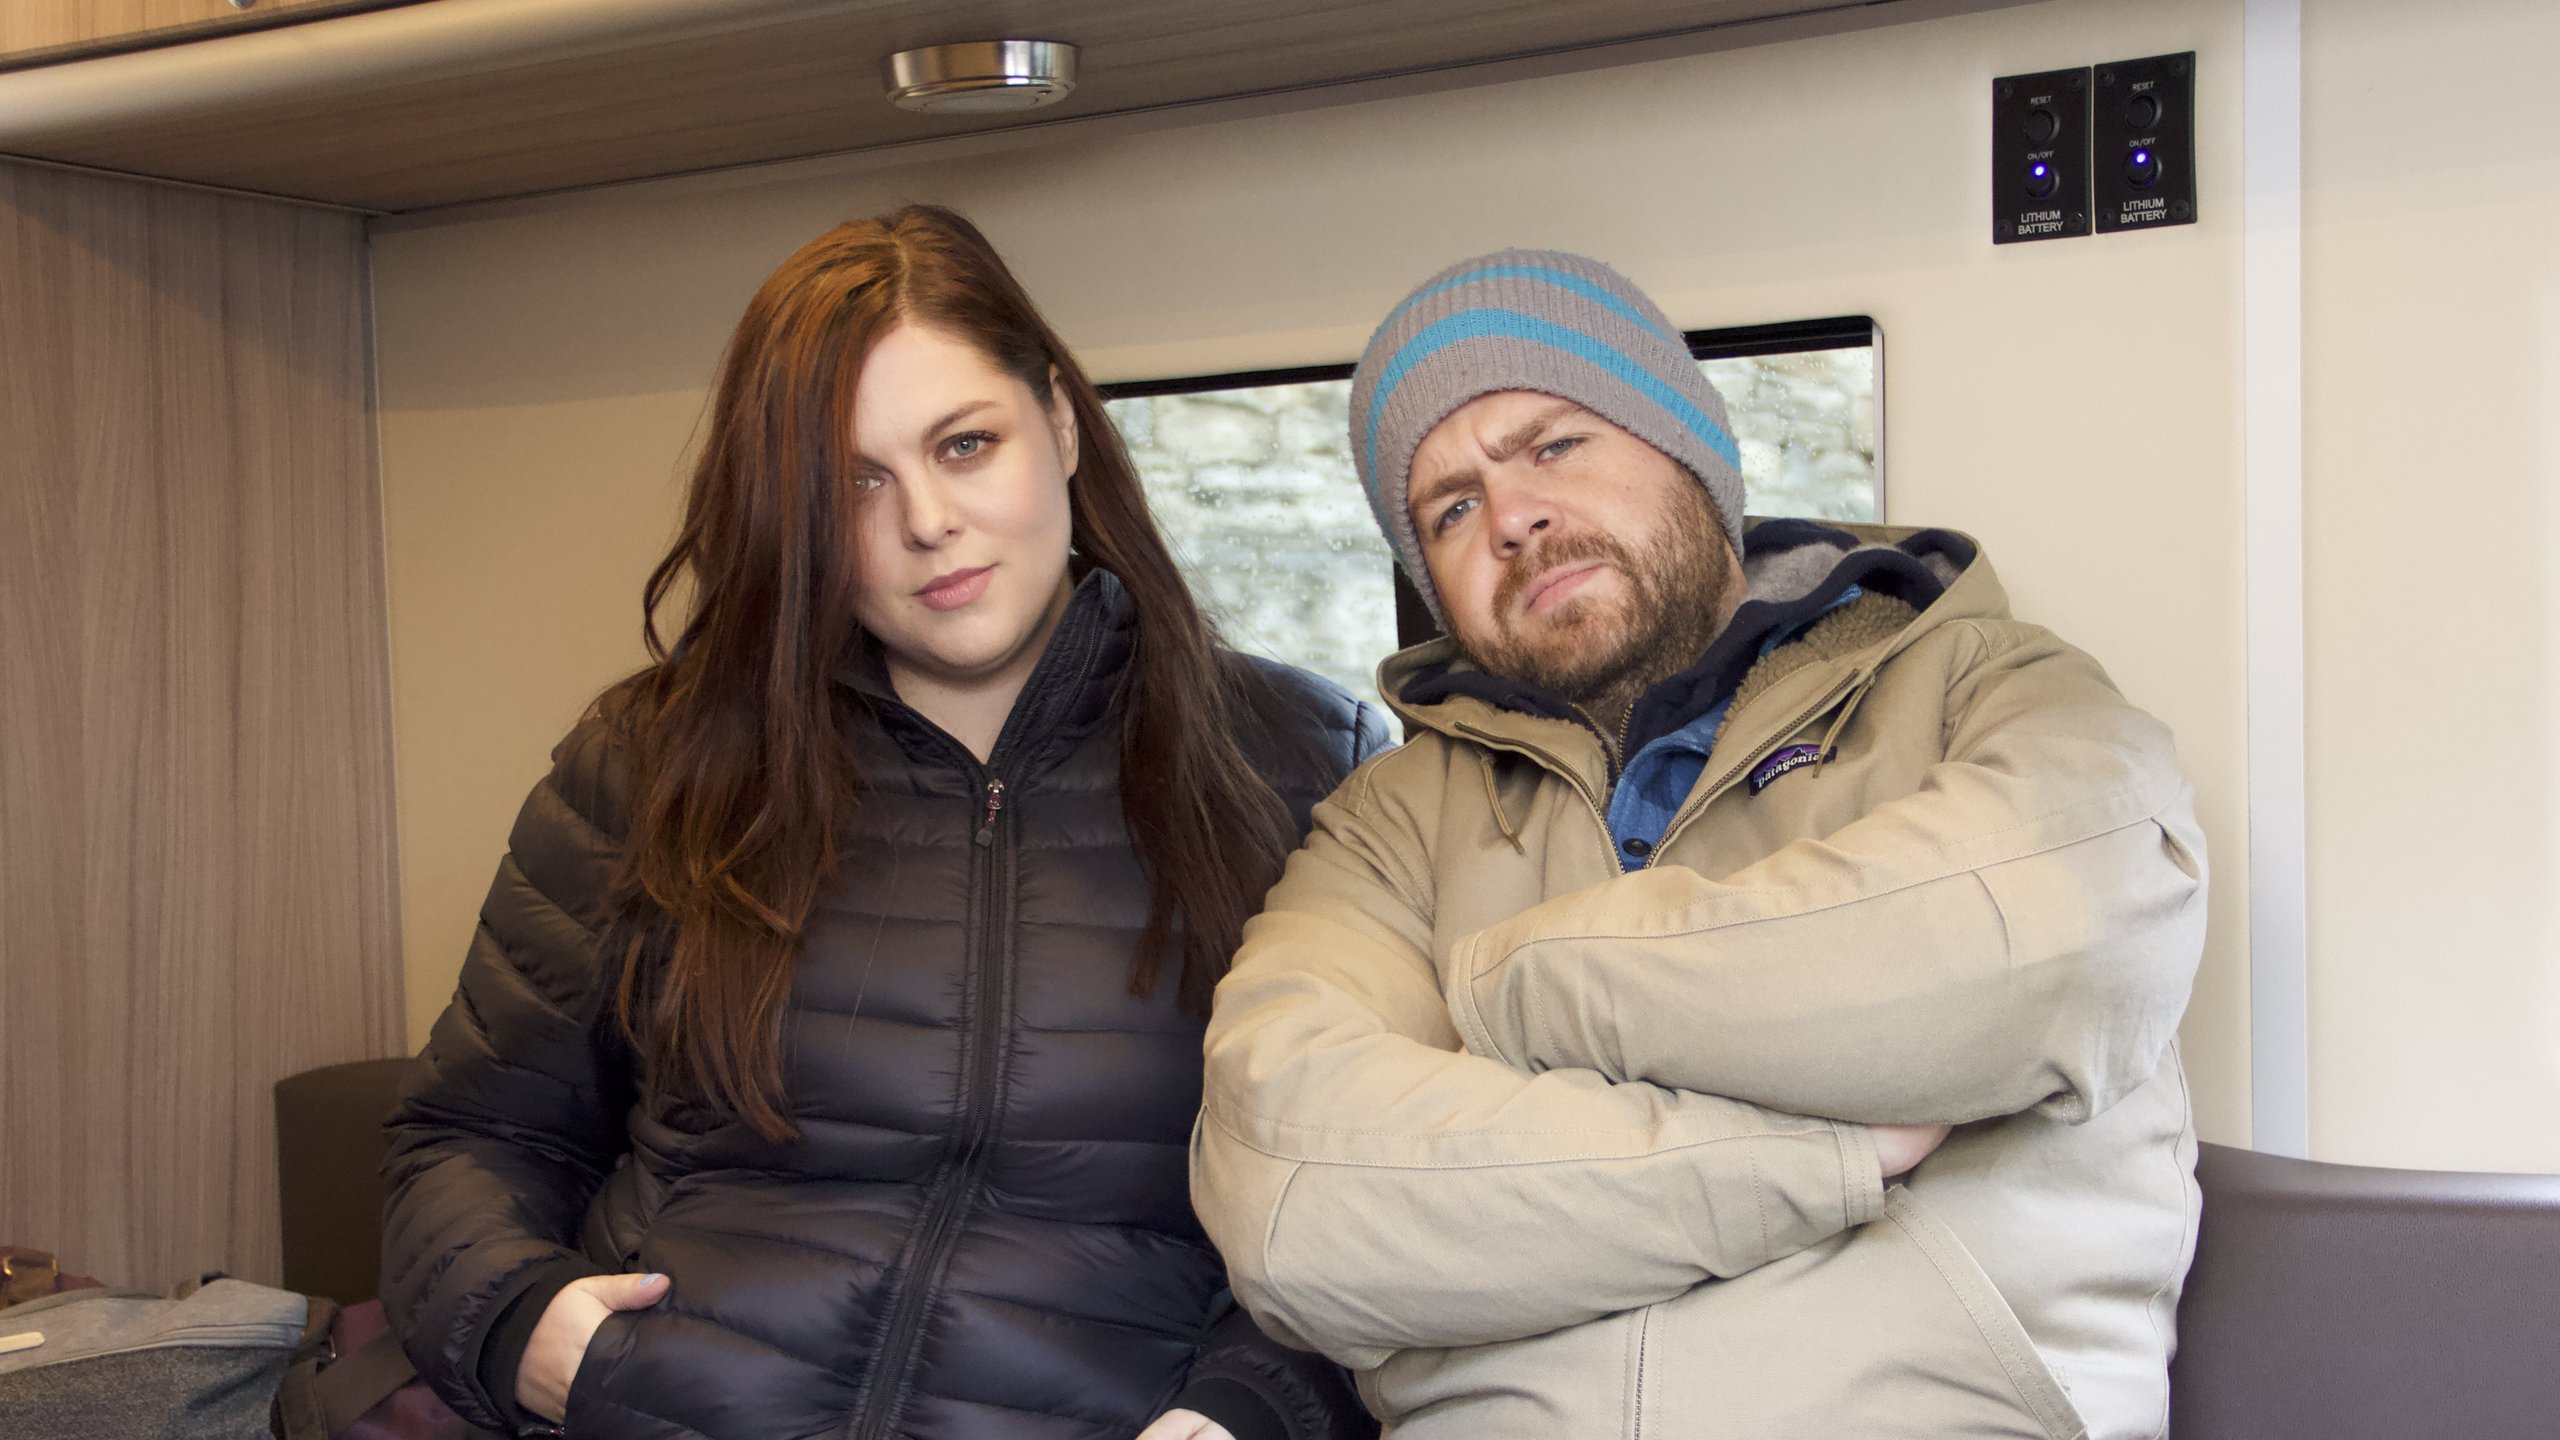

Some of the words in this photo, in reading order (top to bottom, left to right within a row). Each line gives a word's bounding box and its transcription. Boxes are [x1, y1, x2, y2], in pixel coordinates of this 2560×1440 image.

[2129, 137, 2156, 148] ON/OFF
[2027, 151, 2054, 161] ON/OFF
[2123, 198, 2164, 211] LITHIUM
[2021, 210, 2061, 222] LITHIUM
[2120, 210, 2168, 224] BATTERY
[2018, 221, 2064, 235] BATTERY
